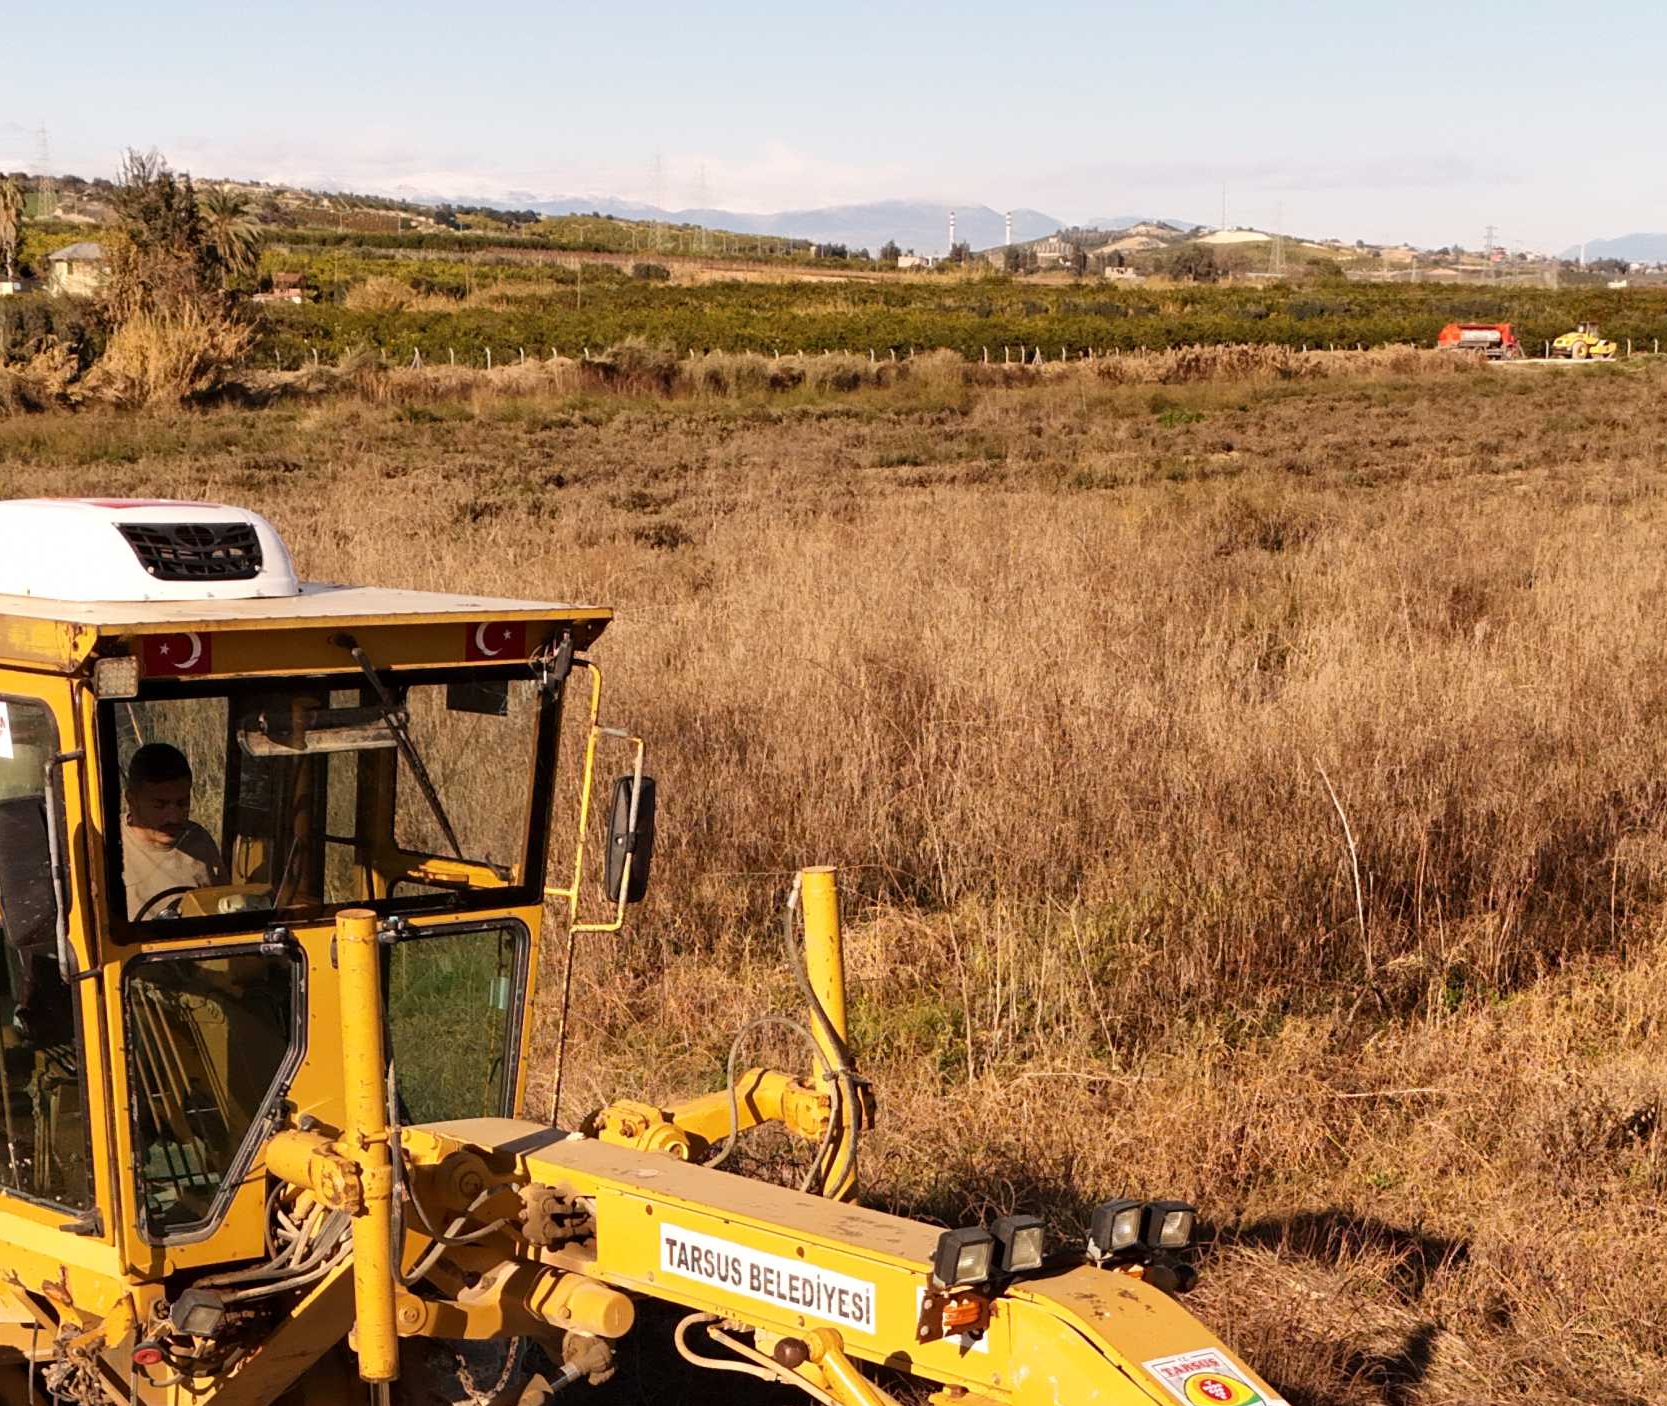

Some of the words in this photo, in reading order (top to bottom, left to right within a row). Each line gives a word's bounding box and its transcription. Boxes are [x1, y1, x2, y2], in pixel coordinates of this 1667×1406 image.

[666, 1237, 742, 1286] TARSUS
[749, 1262, 871, 1324] BELEDİYESİ
[1161, 1357, 1220, 1377] TARSUS
